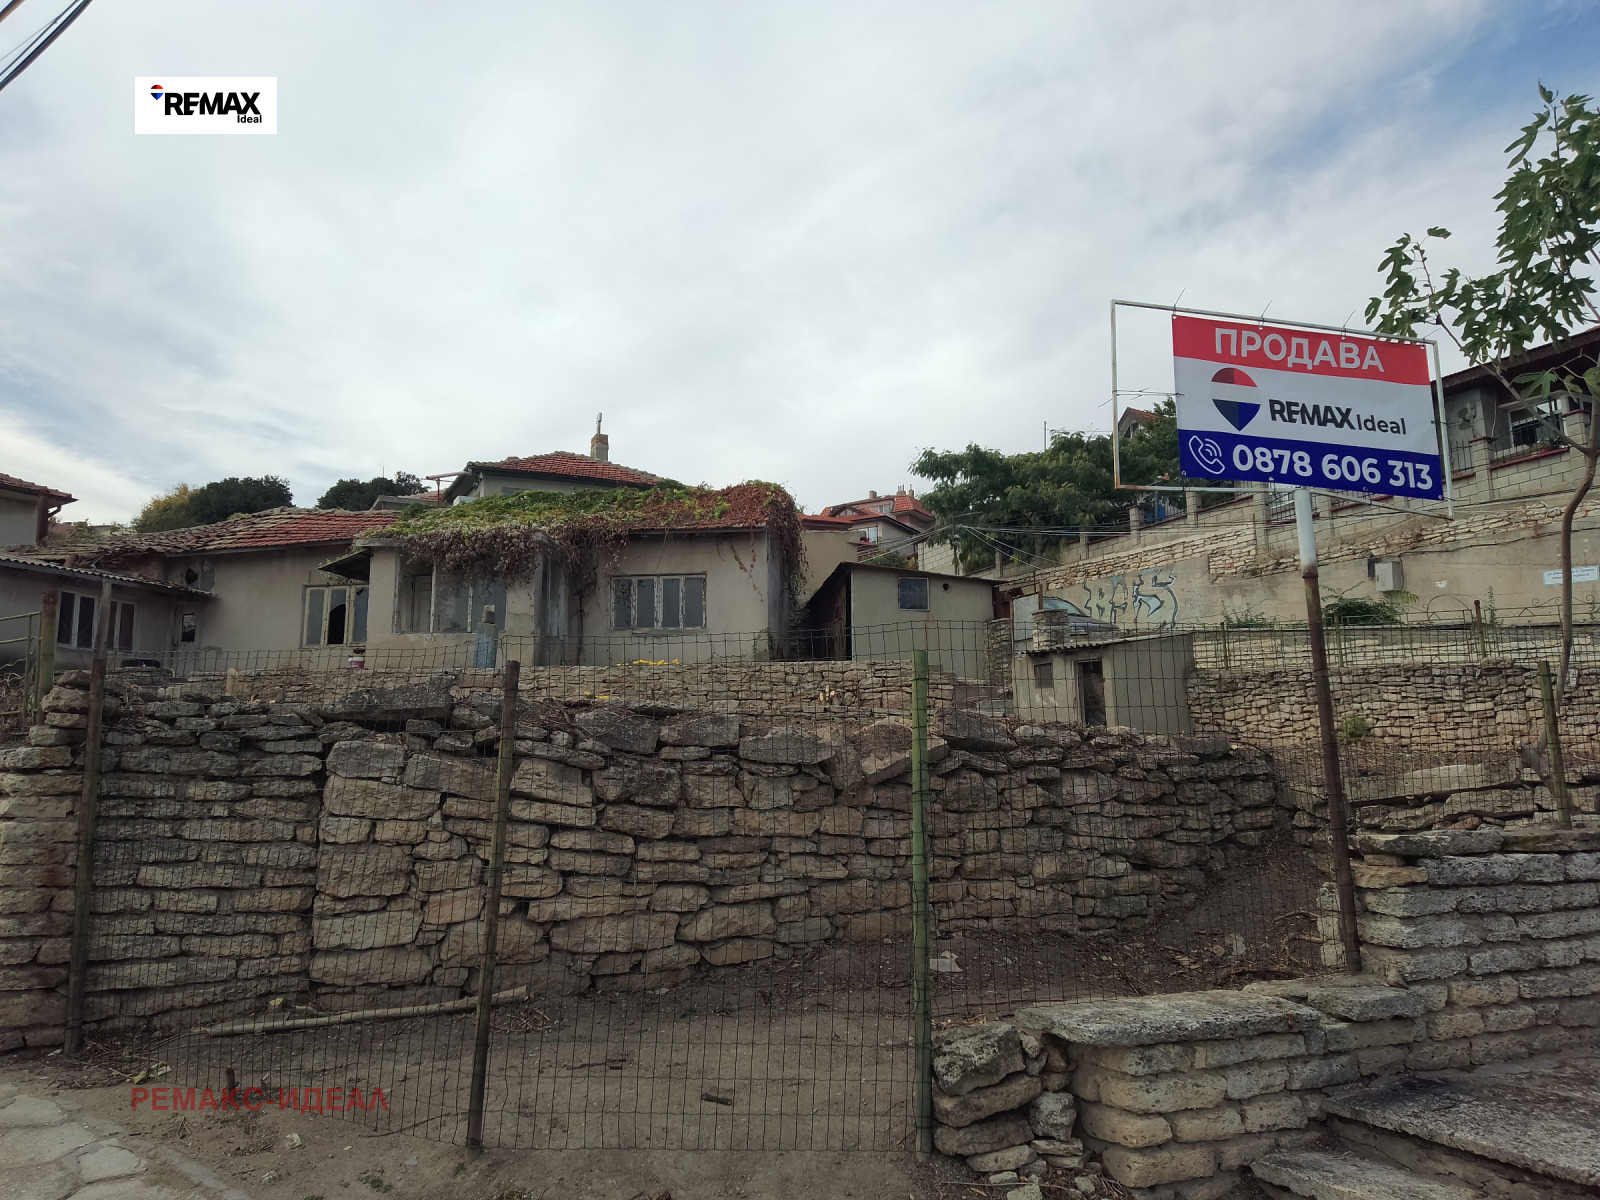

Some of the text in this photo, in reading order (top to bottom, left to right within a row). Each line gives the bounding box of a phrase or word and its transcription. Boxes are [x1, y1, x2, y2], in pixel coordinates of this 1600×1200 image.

[1215, 327, 1385, 373] ПРОДАВА
[1268, 398, 1407, 435] REMAX Ideal
[1232, 444, 1433, 491] 0878 606 313
